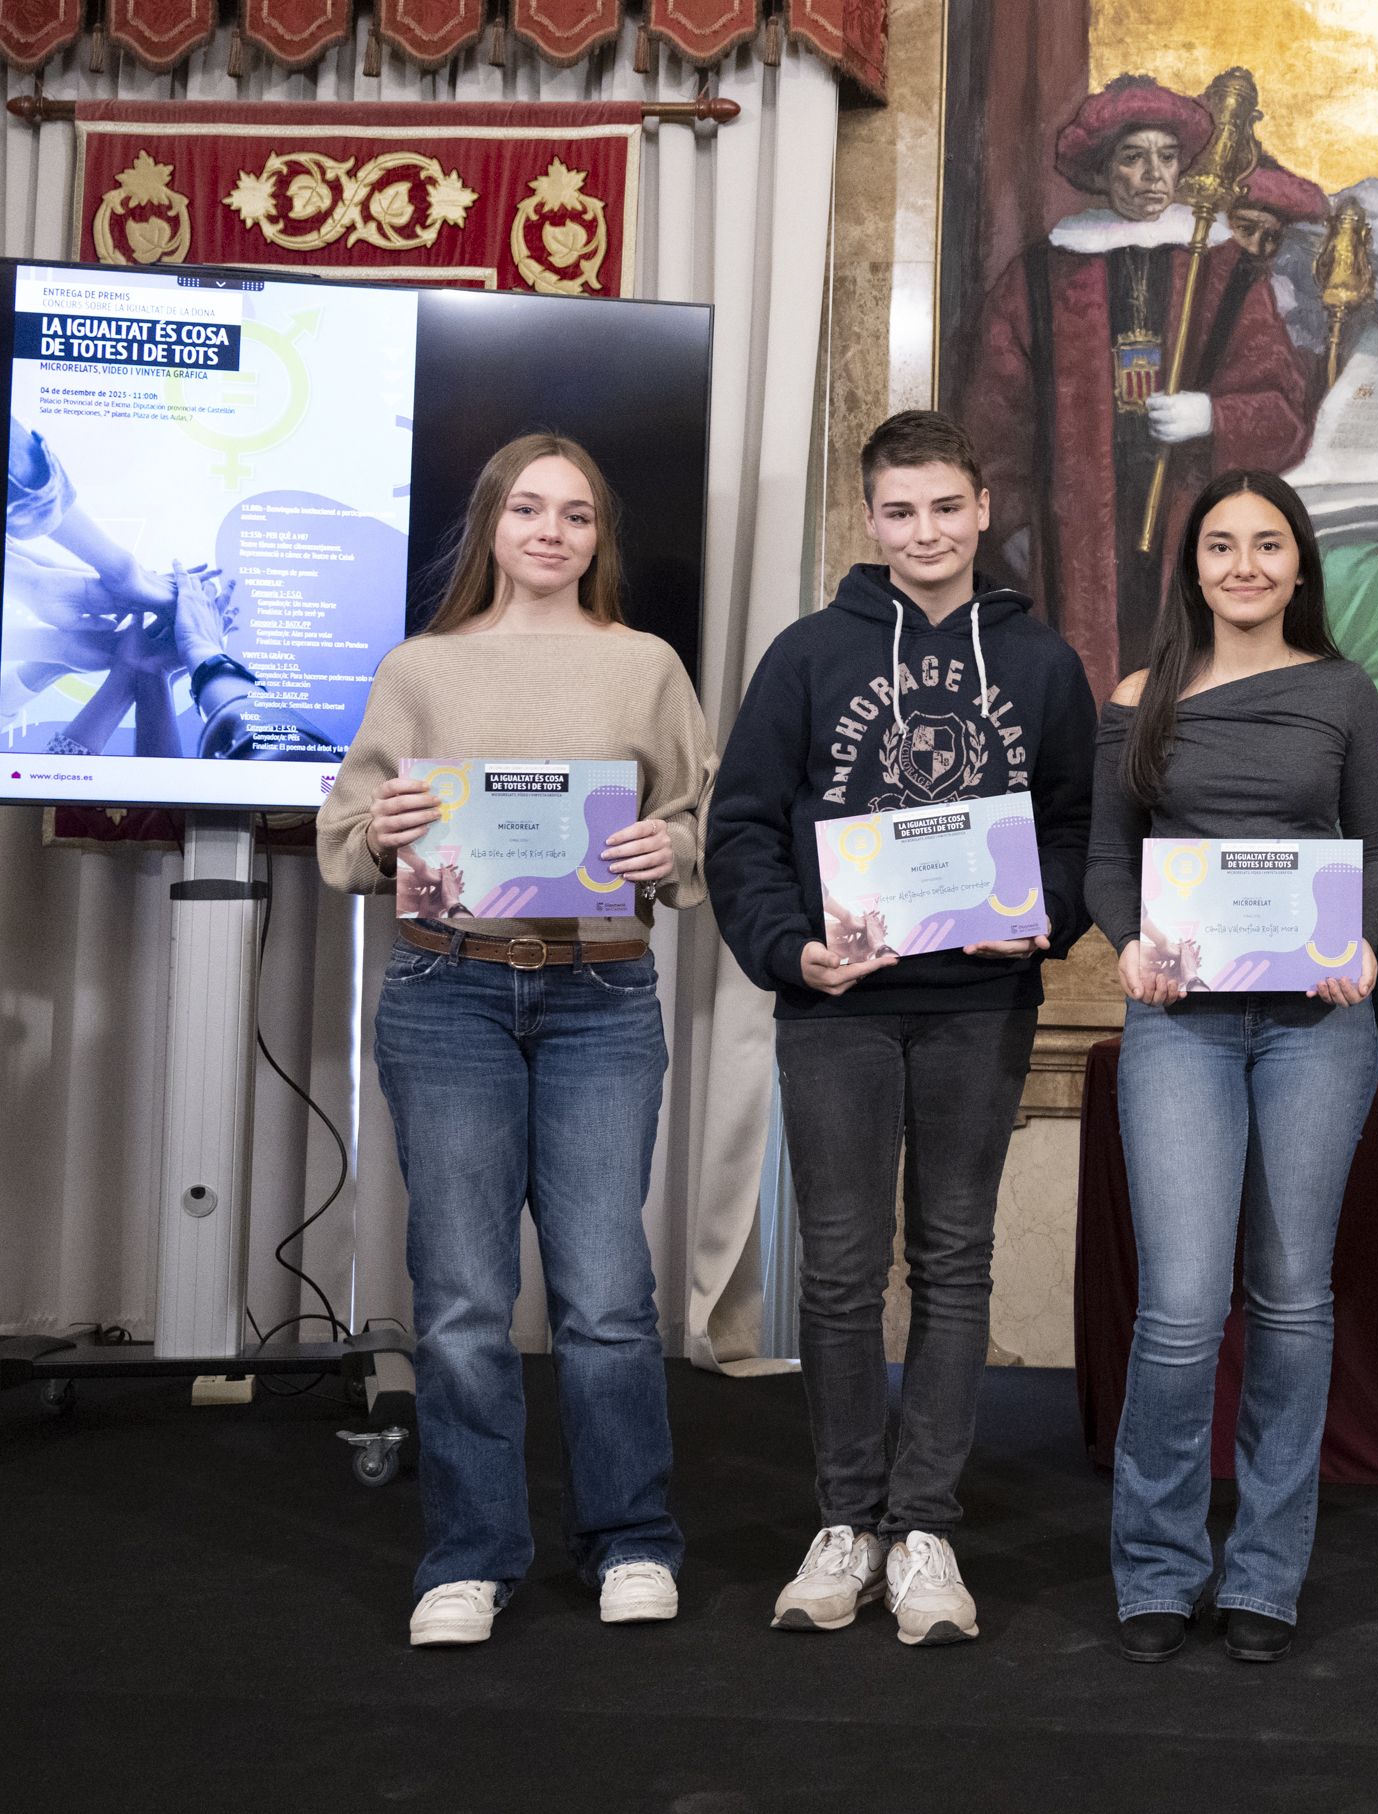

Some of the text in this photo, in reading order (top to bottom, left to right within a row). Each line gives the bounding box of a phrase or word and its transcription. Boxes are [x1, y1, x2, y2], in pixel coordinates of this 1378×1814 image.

[43, 287, 130, 301] ENTREGA DE PREMIS
[42, 299, 215, 317] CONCURS SOBRE LA IGUALTAT DE LA DONA
[42, 316, 229, 345] LA IGUALTAT ÉS COSA
[41, 337, 219, 365] DE TOTES I DE TOTS
[40, 362, 101, 374] MICRORELATS,
[102, 363, 128, 375] VÍDEO
[135, 368, 171, 378] VINYETA
[62, 388, 96, 397] desembre
[167, 404, 196, 412] provincial
[822, 655, 1029, 805] ANCHORAGE ALASK
[30, 772, 93, 782] www.dipcas.es
[500, 774, 533, 782] IGUALTAT
[534, 773, 544, 782] ÉS
[545, 775, 564, 783] COSA
[907, 818, 938, 828] IGUALTAT
[938, 816, 947, 824] ÉS
[948, 814, 966, 823] COSA
[911, 827, 932, 835] TOTES
[947, 822, 964, 830] TOTS
[506, 849, 516, 858] de
[517, 848, 528, 858] los
[1267, 852, 1275, 860] ÉS
[911, 862, 949, 872] MICRORELAT
